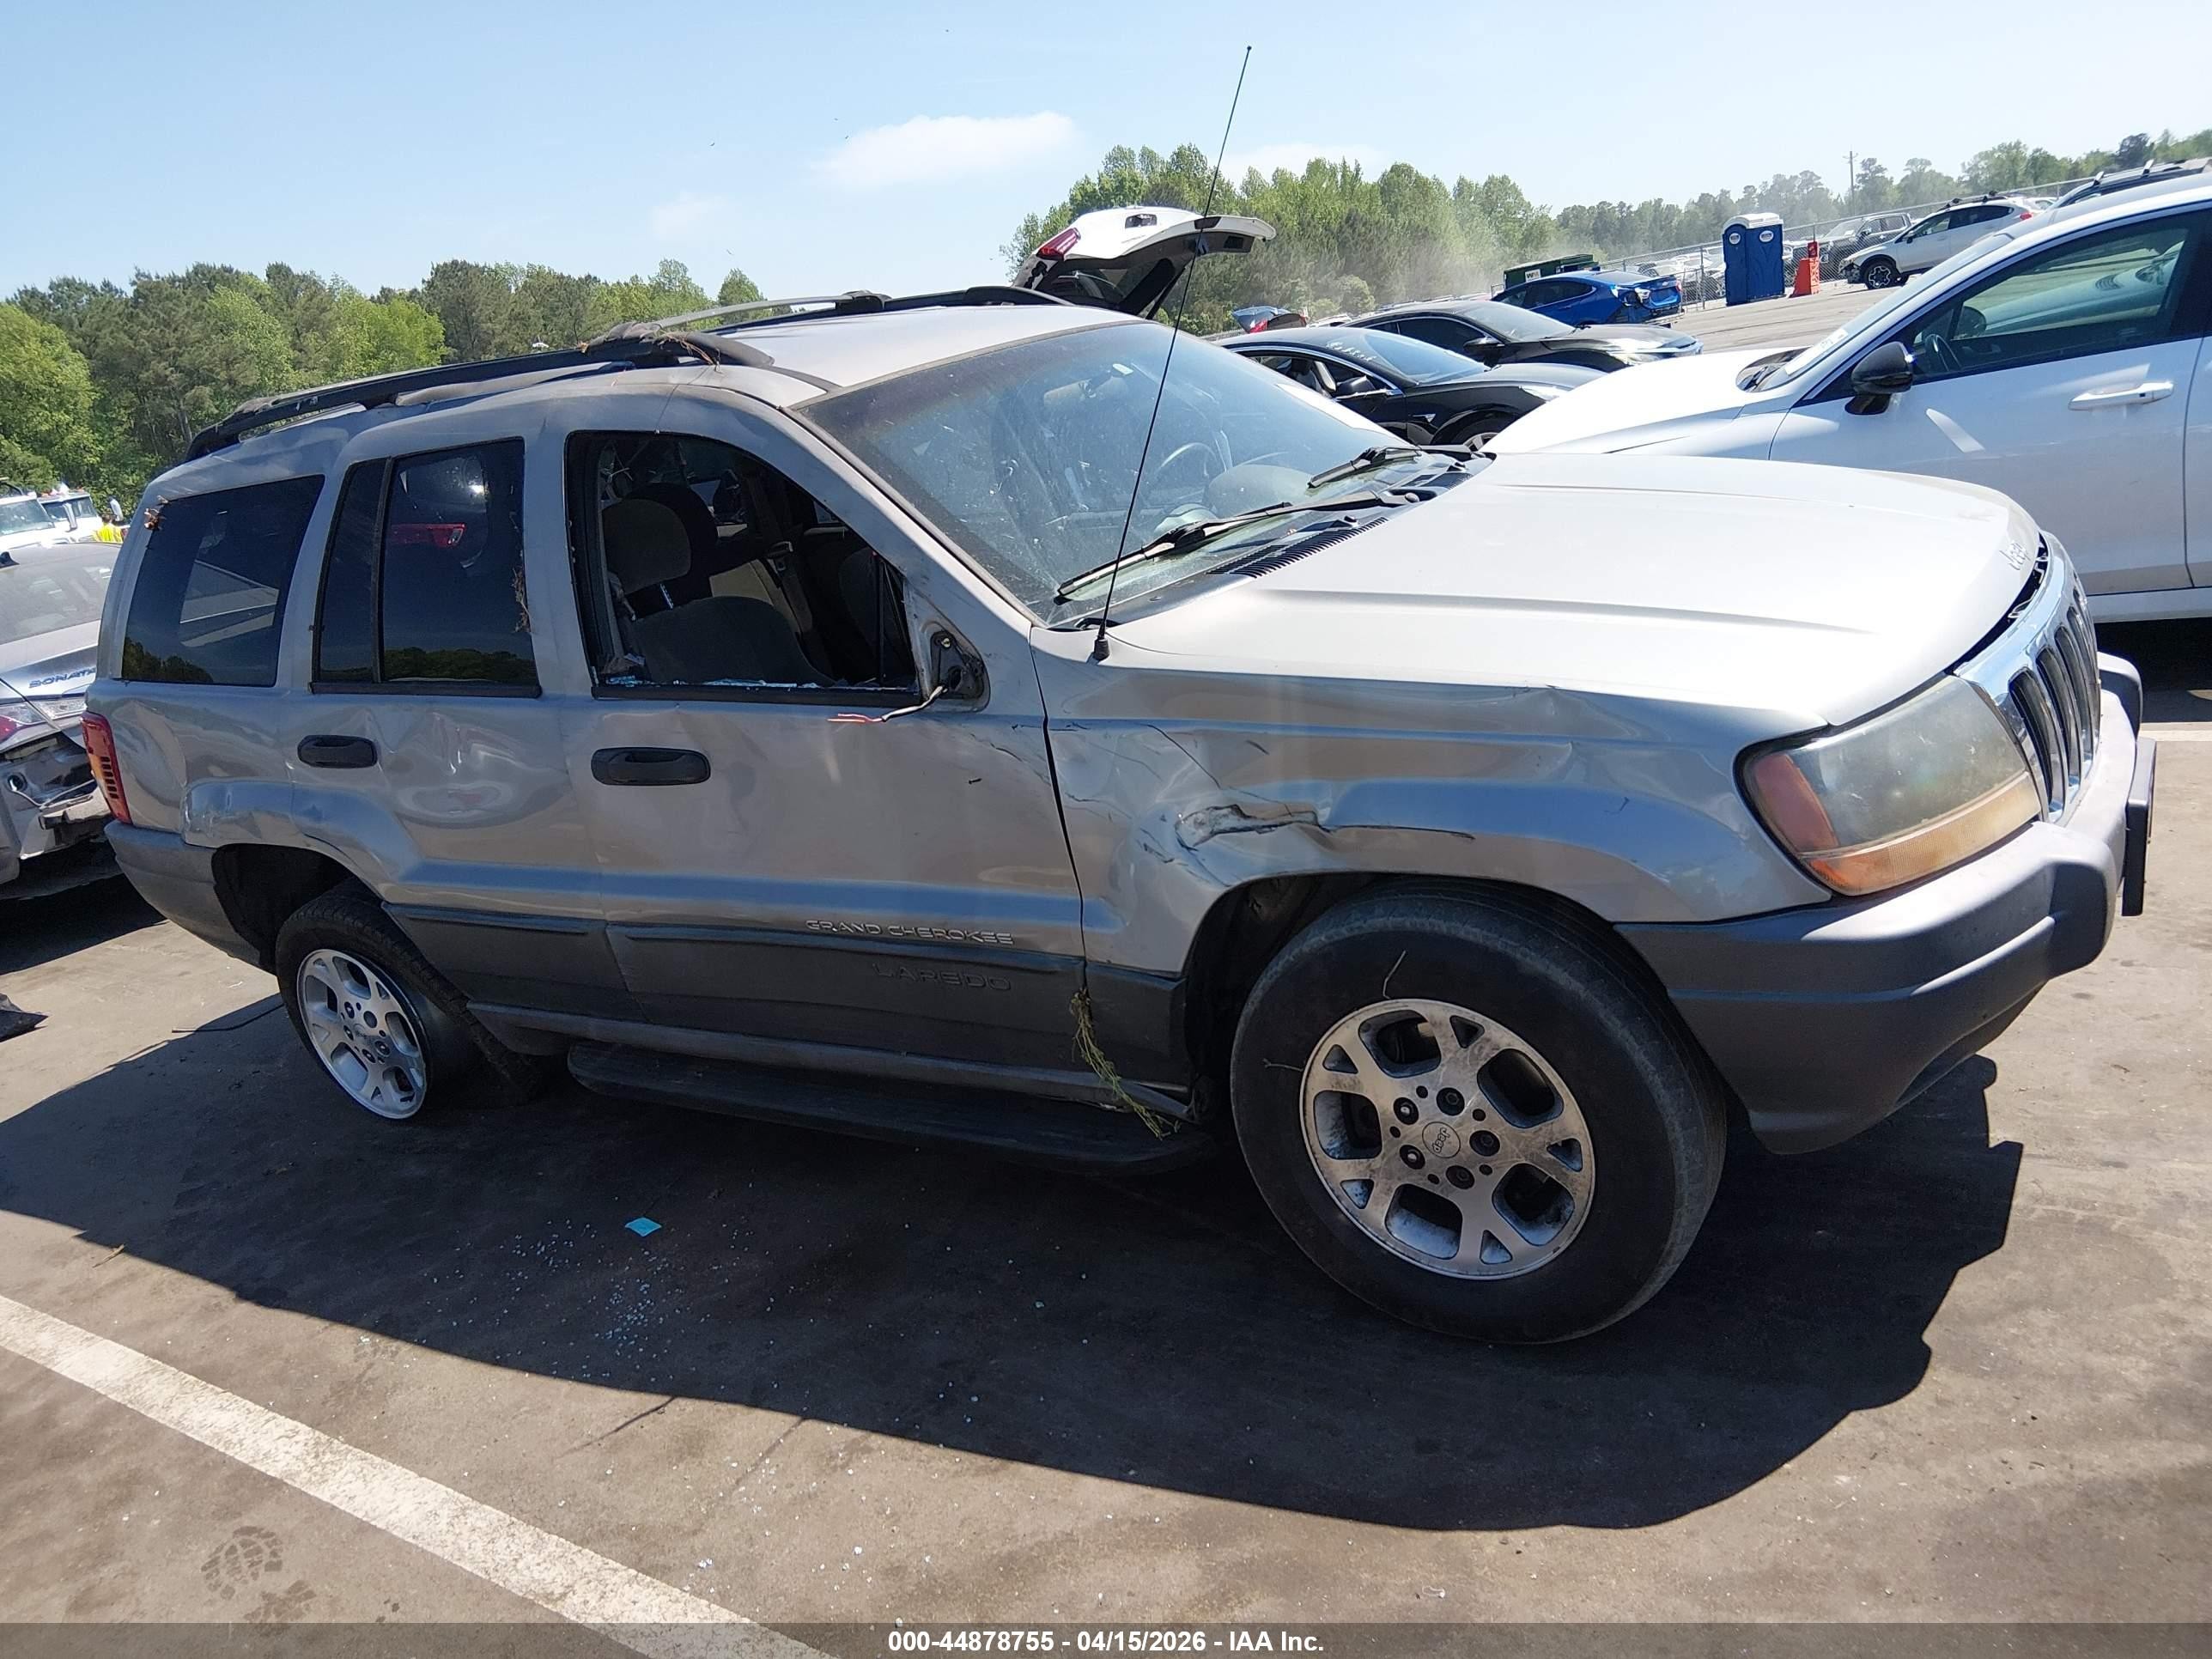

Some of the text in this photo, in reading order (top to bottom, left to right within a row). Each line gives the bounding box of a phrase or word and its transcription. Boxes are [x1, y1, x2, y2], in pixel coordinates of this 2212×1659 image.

[805, 920, 1015, 945] GRAND CHEROKEE
[872, 963, 1012, 991] LAREDO
[1431, 1127, 1451, 1153] Jeep
